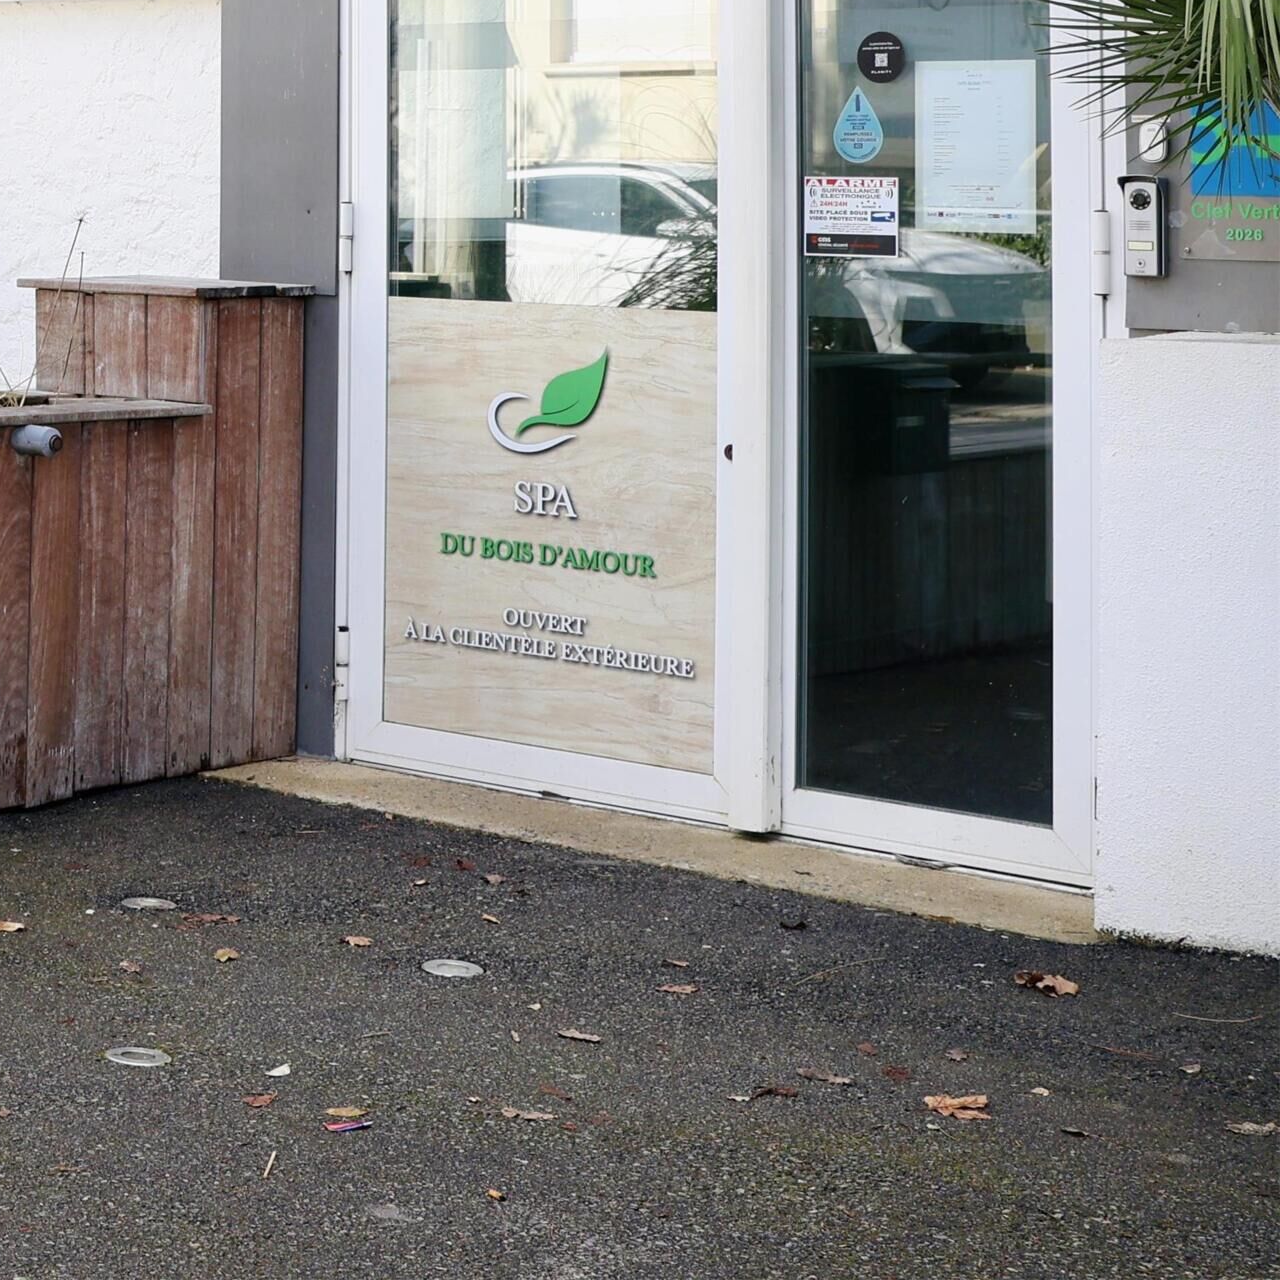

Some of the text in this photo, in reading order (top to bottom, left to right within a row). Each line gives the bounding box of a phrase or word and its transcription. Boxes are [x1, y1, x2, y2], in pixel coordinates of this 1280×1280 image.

[806, 178, 895, 188] ALARME
[1191, 202, 1234, 219] Clef
[1225, 228, 1264, 241] 2026
[514, 480, 578, 518] SPA
[440, 532, 476, 557] DU
[480, 537, 534, 565] BOIS
[503, 607, 587, 636] OUVERT
[404, 616, 695, 678] À LA CLIENTÈLE EXTÉRIEURE
